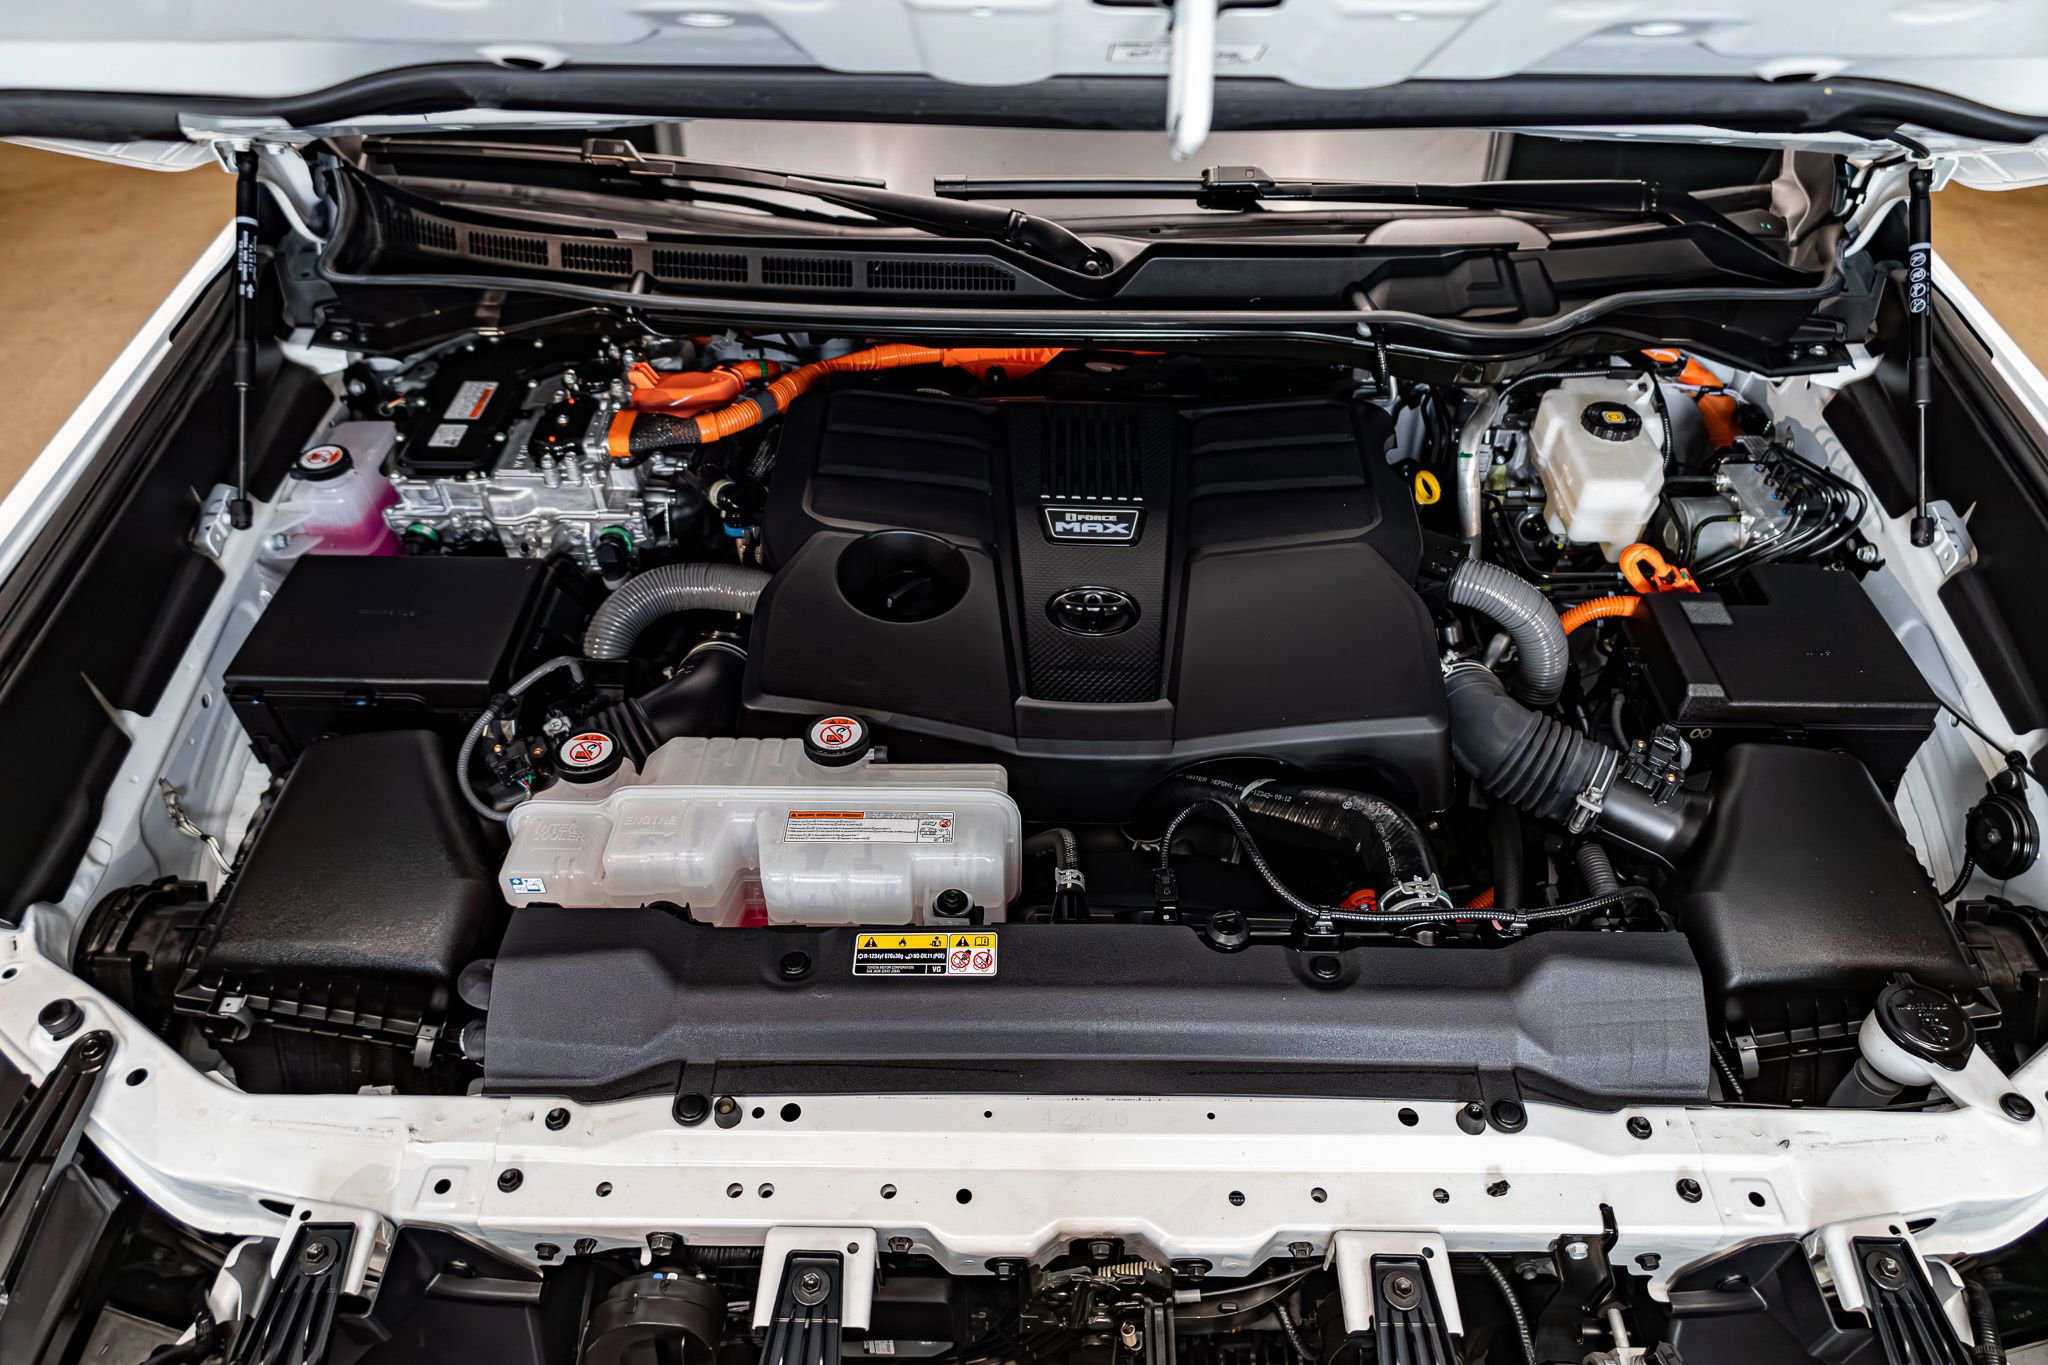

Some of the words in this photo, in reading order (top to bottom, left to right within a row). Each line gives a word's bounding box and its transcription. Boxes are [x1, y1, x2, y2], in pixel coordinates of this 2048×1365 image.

[1055, 521, 1130, 534] MAX
[623, 815, 678, 825] ENGINE
[535, 823, 579, 833] INTER
[533, 832, 585, 842] COOLER
